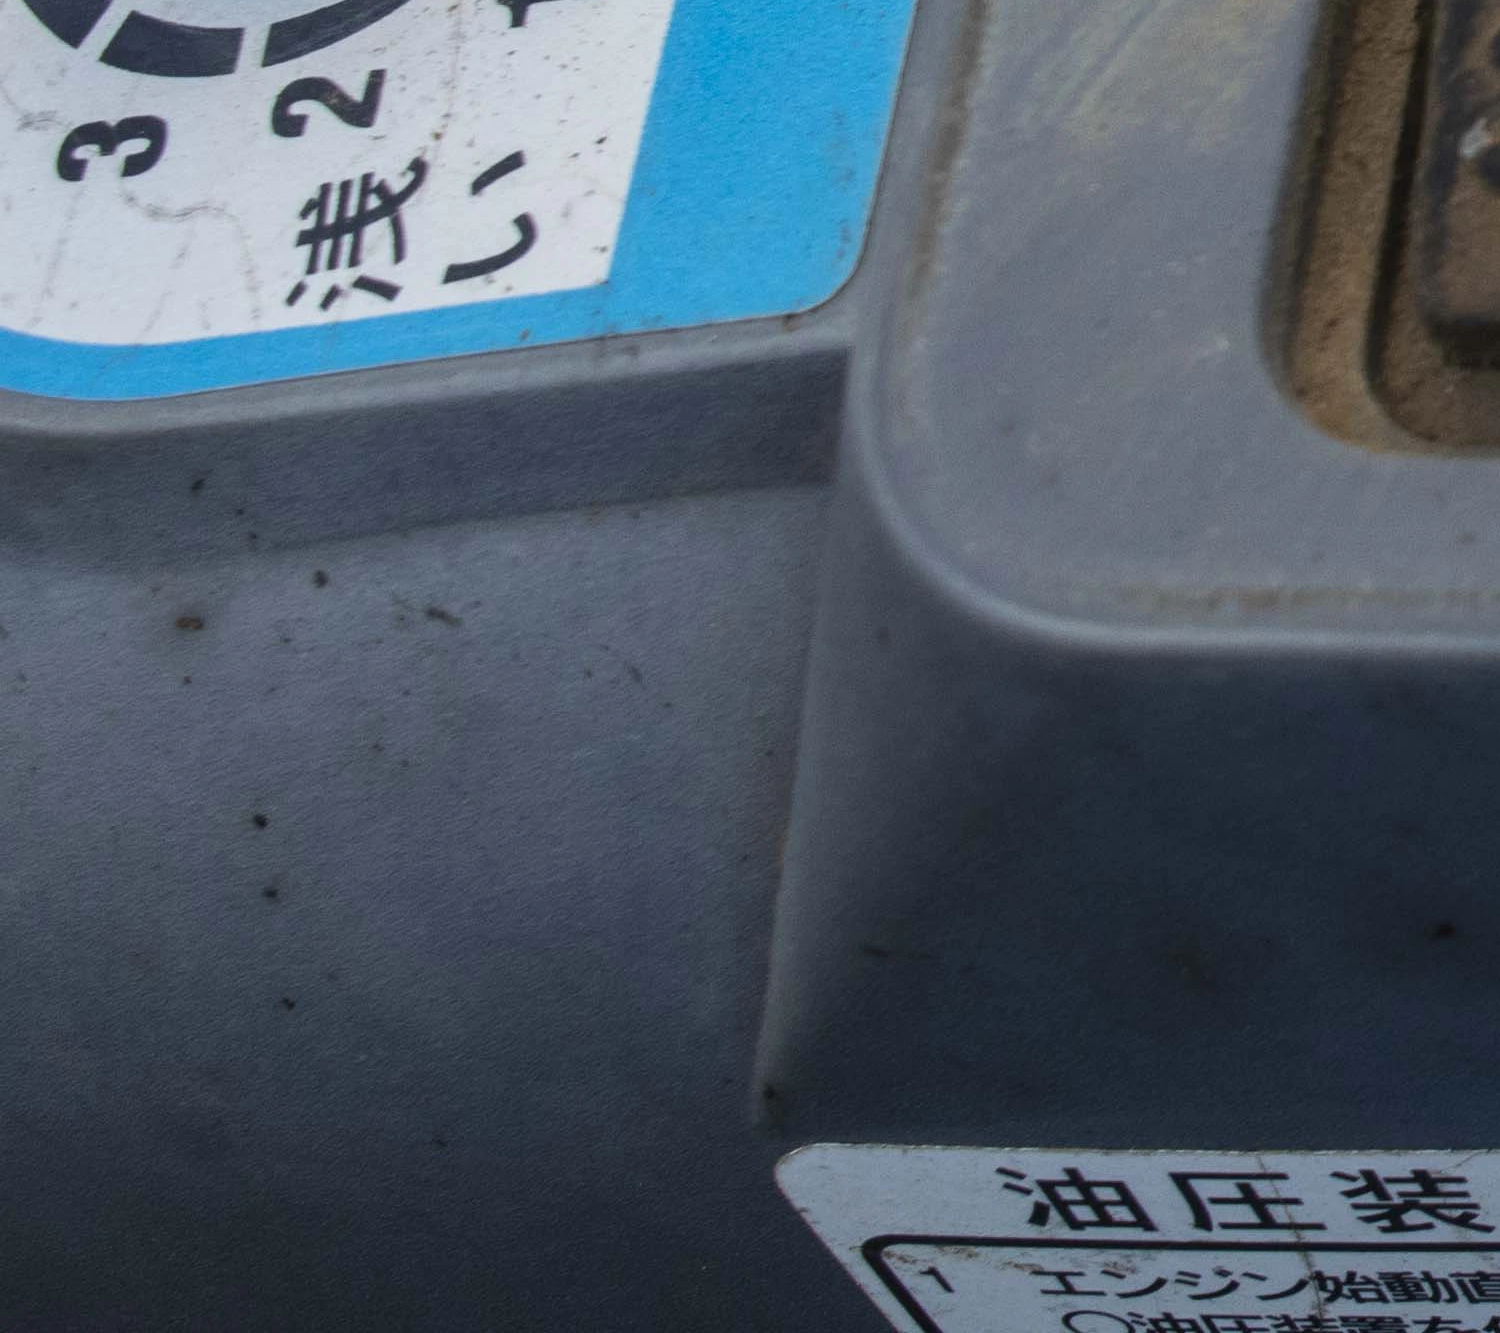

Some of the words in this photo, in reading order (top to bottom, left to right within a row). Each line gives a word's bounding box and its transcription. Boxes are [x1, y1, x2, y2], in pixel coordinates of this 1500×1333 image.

[271, 69, 385, 139] 2
[56, 115, 169, 183] 3
[286, 148, 538, 311] 浅い
